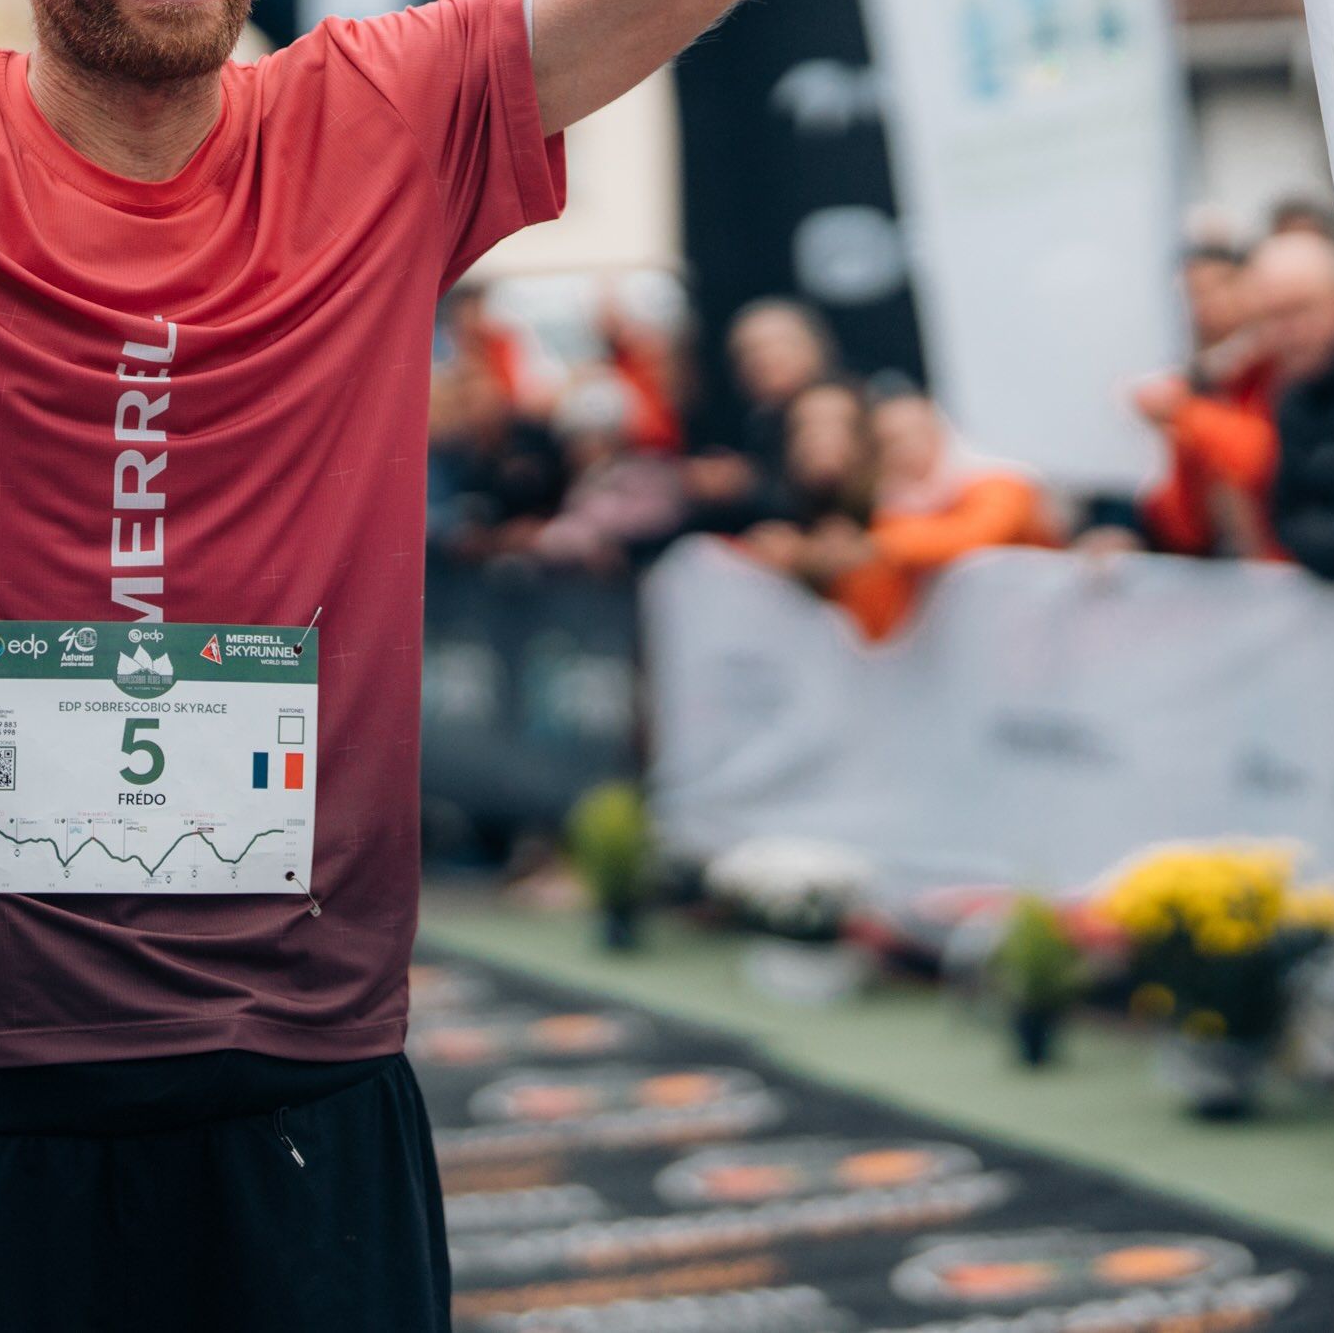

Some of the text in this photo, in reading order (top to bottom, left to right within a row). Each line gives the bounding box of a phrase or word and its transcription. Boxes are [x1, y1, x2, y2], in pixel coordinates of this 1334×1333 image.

[111, 315, 177, 623] MERREL
[143, 629, 164, 642] edp
[226, 634, 284, 645] MERRELL
[8, 633, 48, 659] edp
[61, 652, 94, 661] Asturias
[59, 702, 227, 714] EDP SOBRESCOBIO SKYRACE
[119, 718, 165, 785] 5
[119, 790, 166, 805] FRÉDO
